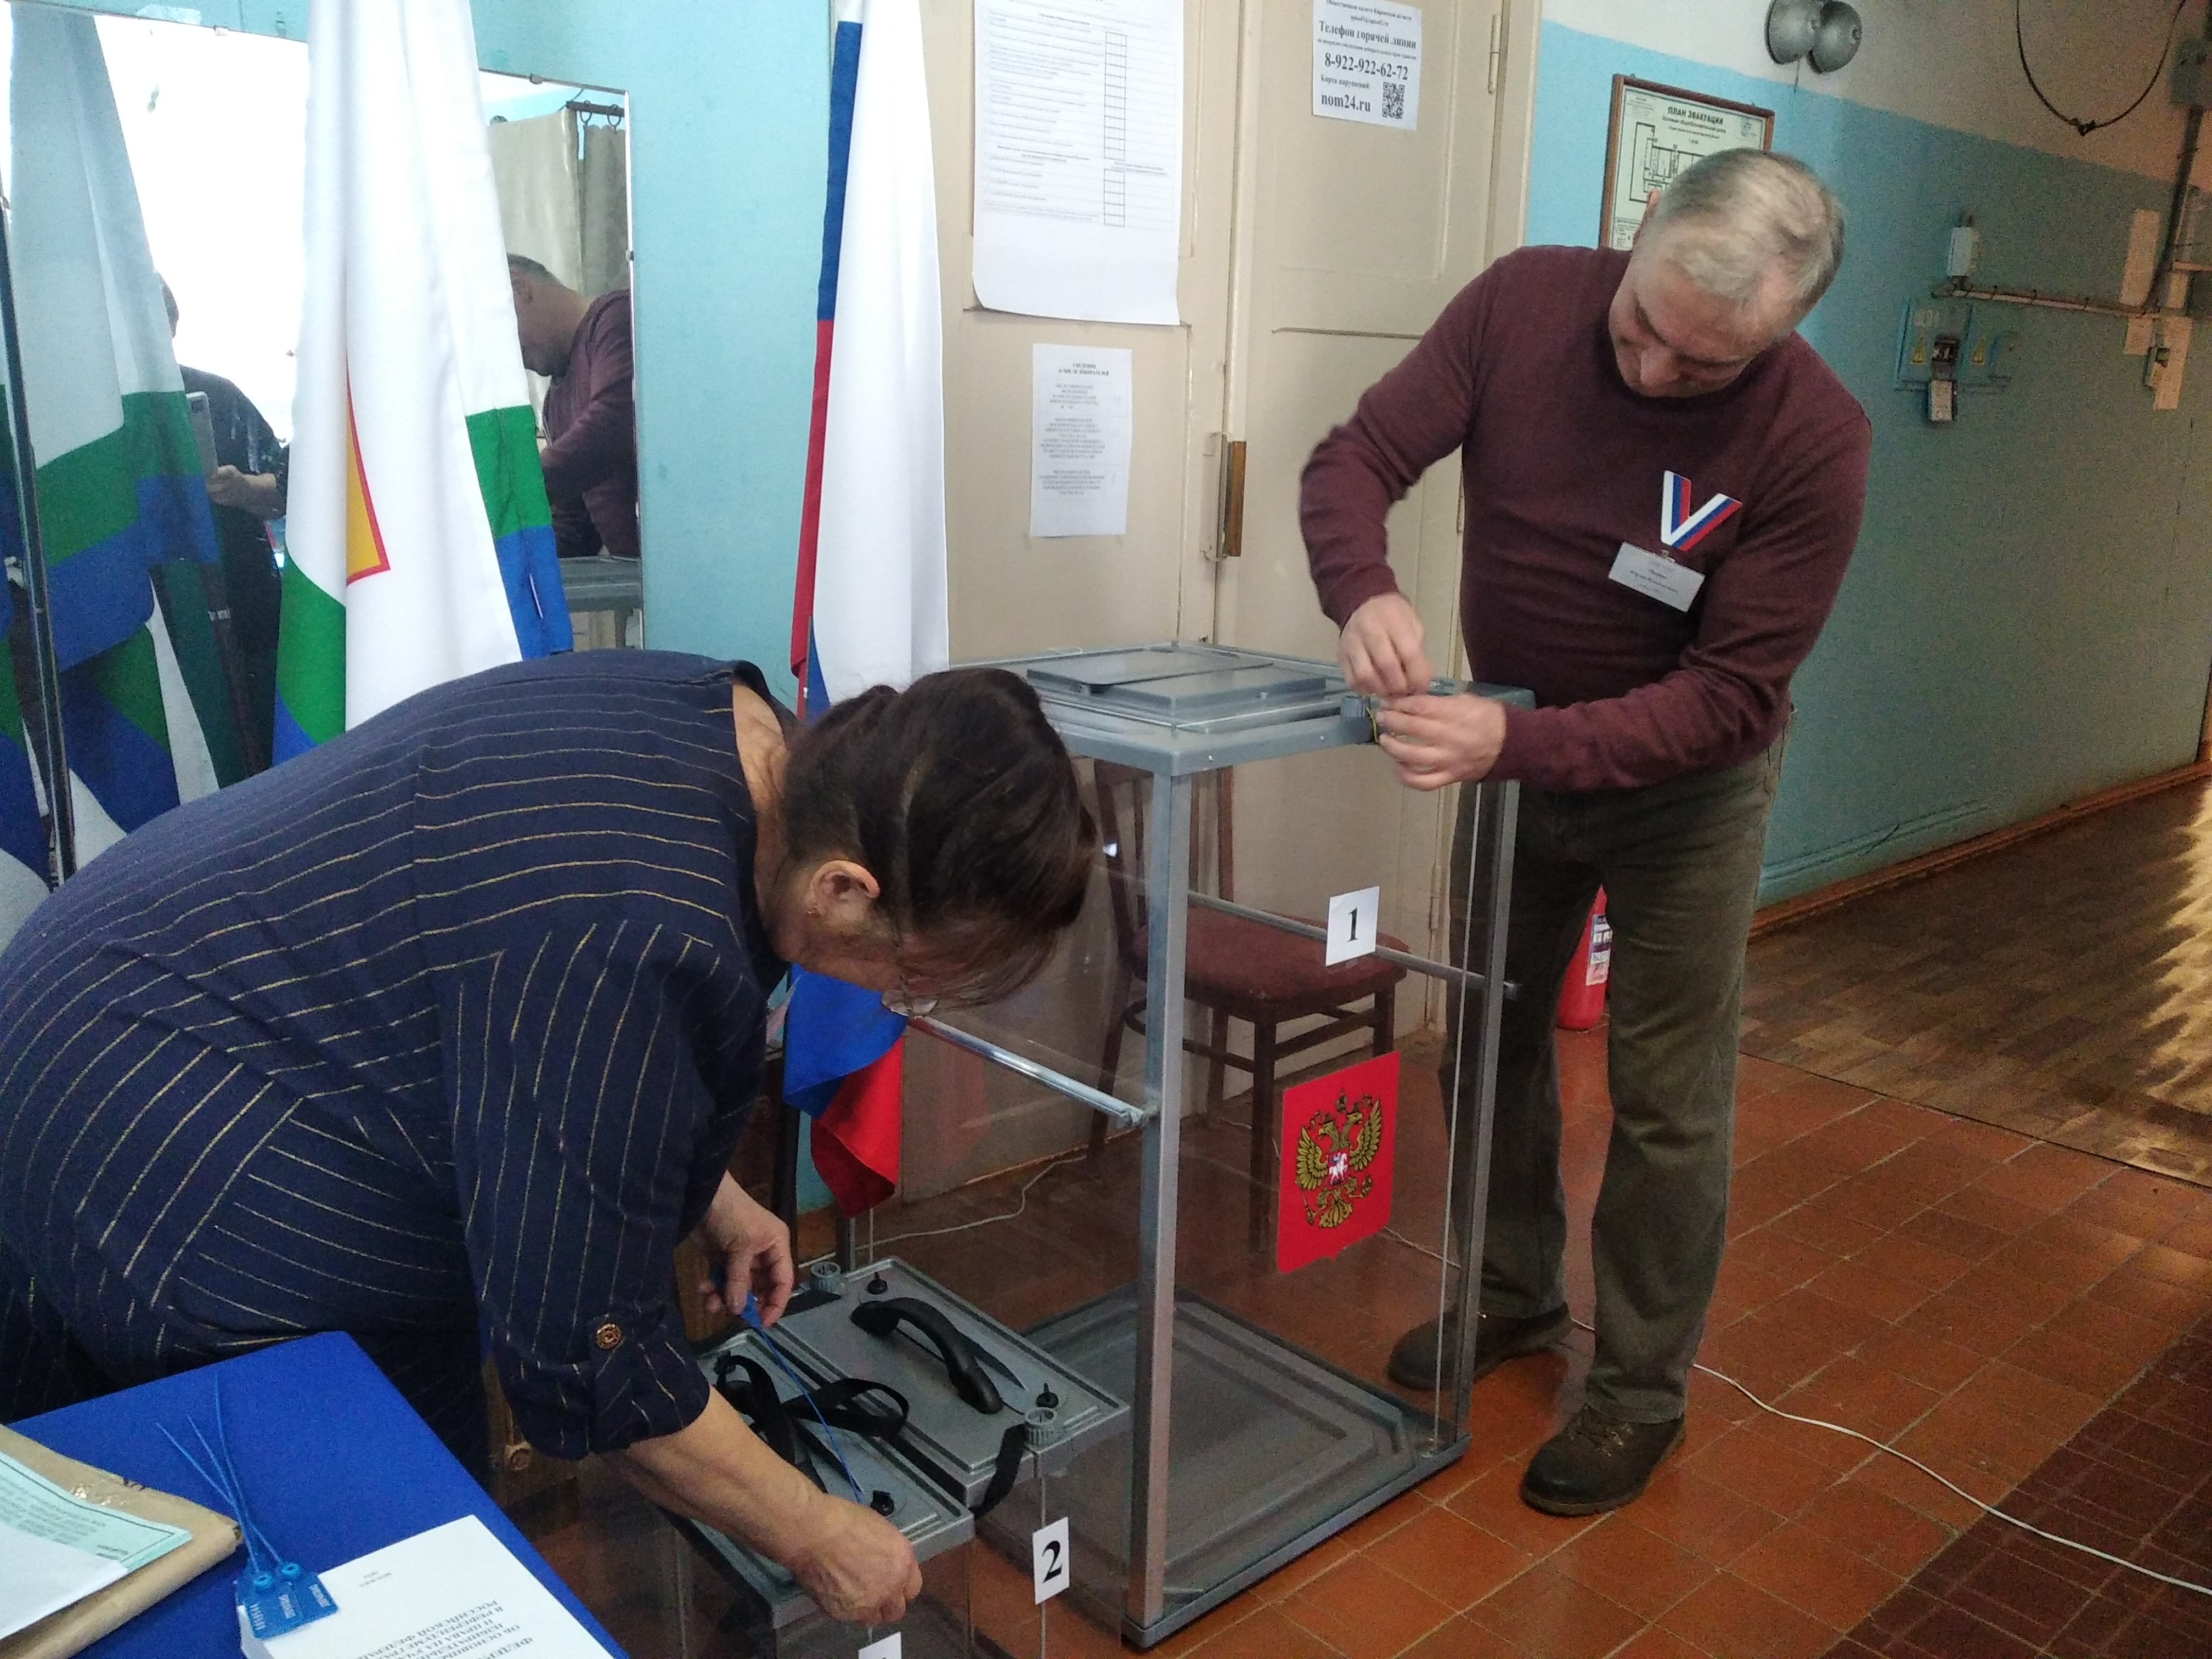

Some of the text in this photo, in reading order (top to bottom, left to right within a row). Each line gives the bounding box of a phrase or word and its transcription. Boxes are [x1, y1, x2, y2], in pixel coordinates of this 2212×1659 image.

[1319, 20, 1417, 49] Телефон горячей линии
[1321, 74, 1338, 84] Карта
[1324, 52, 1408, 80] 8-922-922-62-72
[1321, 94, 1371, 112] nom24.ru
[1667, 106, 1724, 125] ПЛАН ЭВАКУАЦИИ
[1347, 907, 1358, 943] 1
[1041, 1540, 1063, 1584] 2
[410, 1610, 493, 1648] РЕФЕРЕНДУМЕ
[417, 1599, 498, 1637] РОССИЙСКОЙ
[444, 1623, 482, 1641] ПРАВА
[503, 1624, 520, 1634] ОБ
